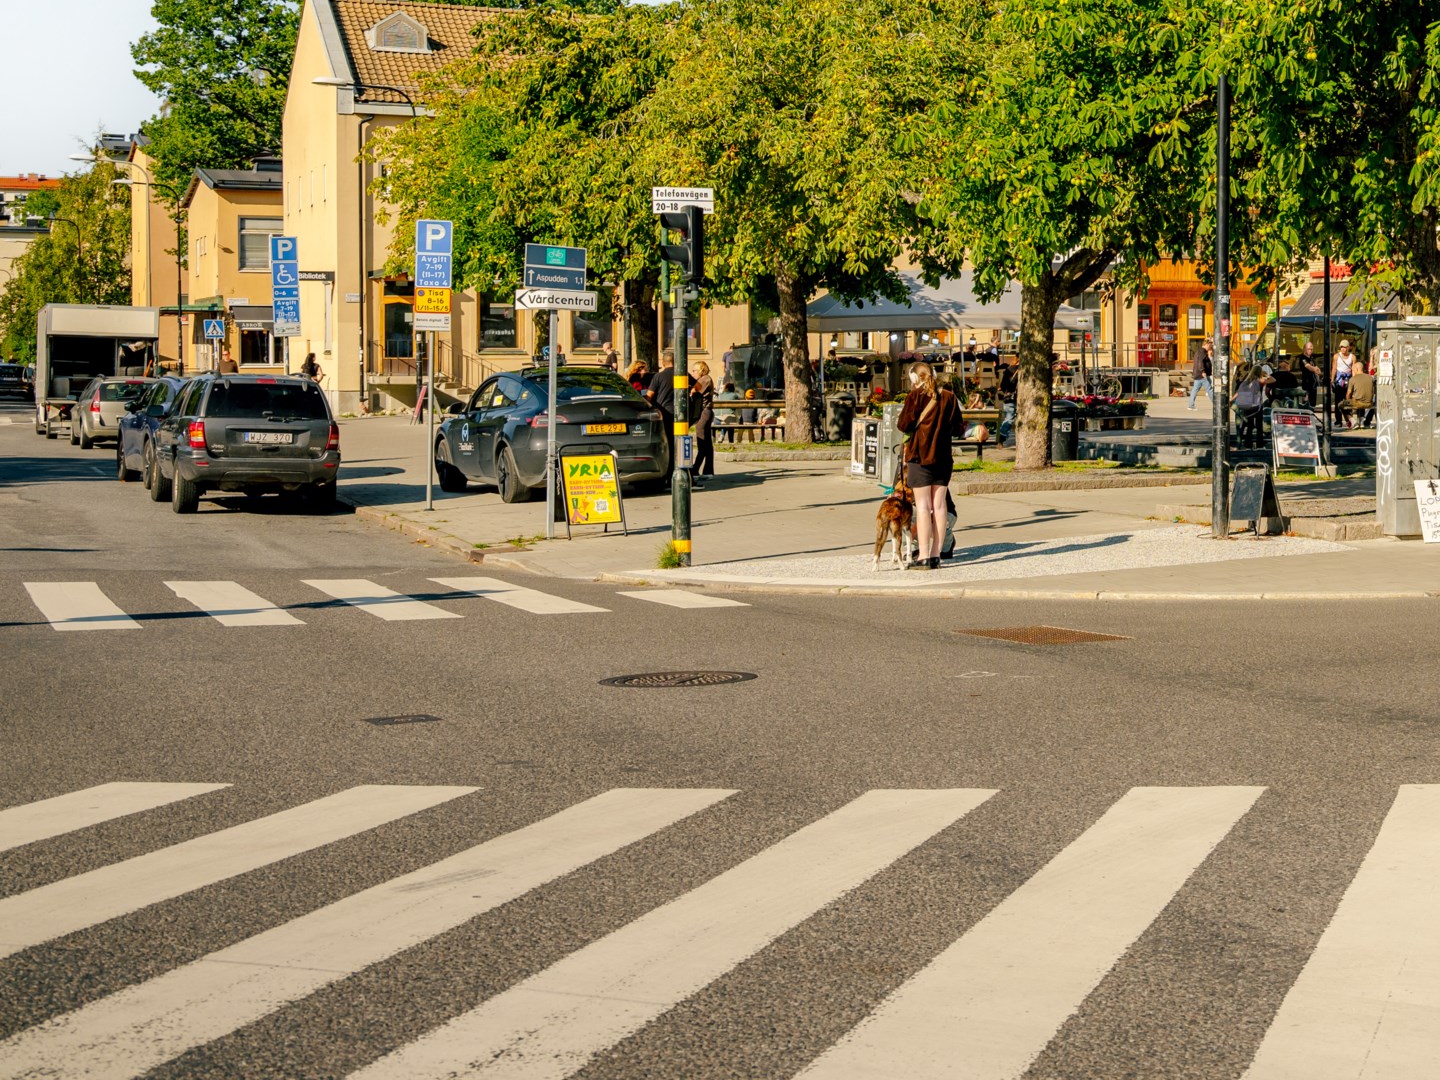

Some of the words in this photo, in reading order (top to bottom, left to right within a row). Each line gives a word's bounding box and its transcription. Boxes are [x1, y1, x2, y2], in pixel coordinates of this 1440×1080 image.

[655, 189, 709, 200] Telefonvägen
[656, 202, 679, 211] 20-18
[425, 223, 446, 250] P
[277, 239, 293, 259] P
[421, 255, 447, 264] Avgift
[421, 271, 446, 279] (11-17)
[536, 273, 569, 283] Aspudden
[574, 277, 583, 285] 1,1
[528, 294, 594, 307] Vårdcentral
[589, 424, 606, 433] AEE
[250, 433, 267, 441] WJZ
[273, 433, 291, 441] 370
